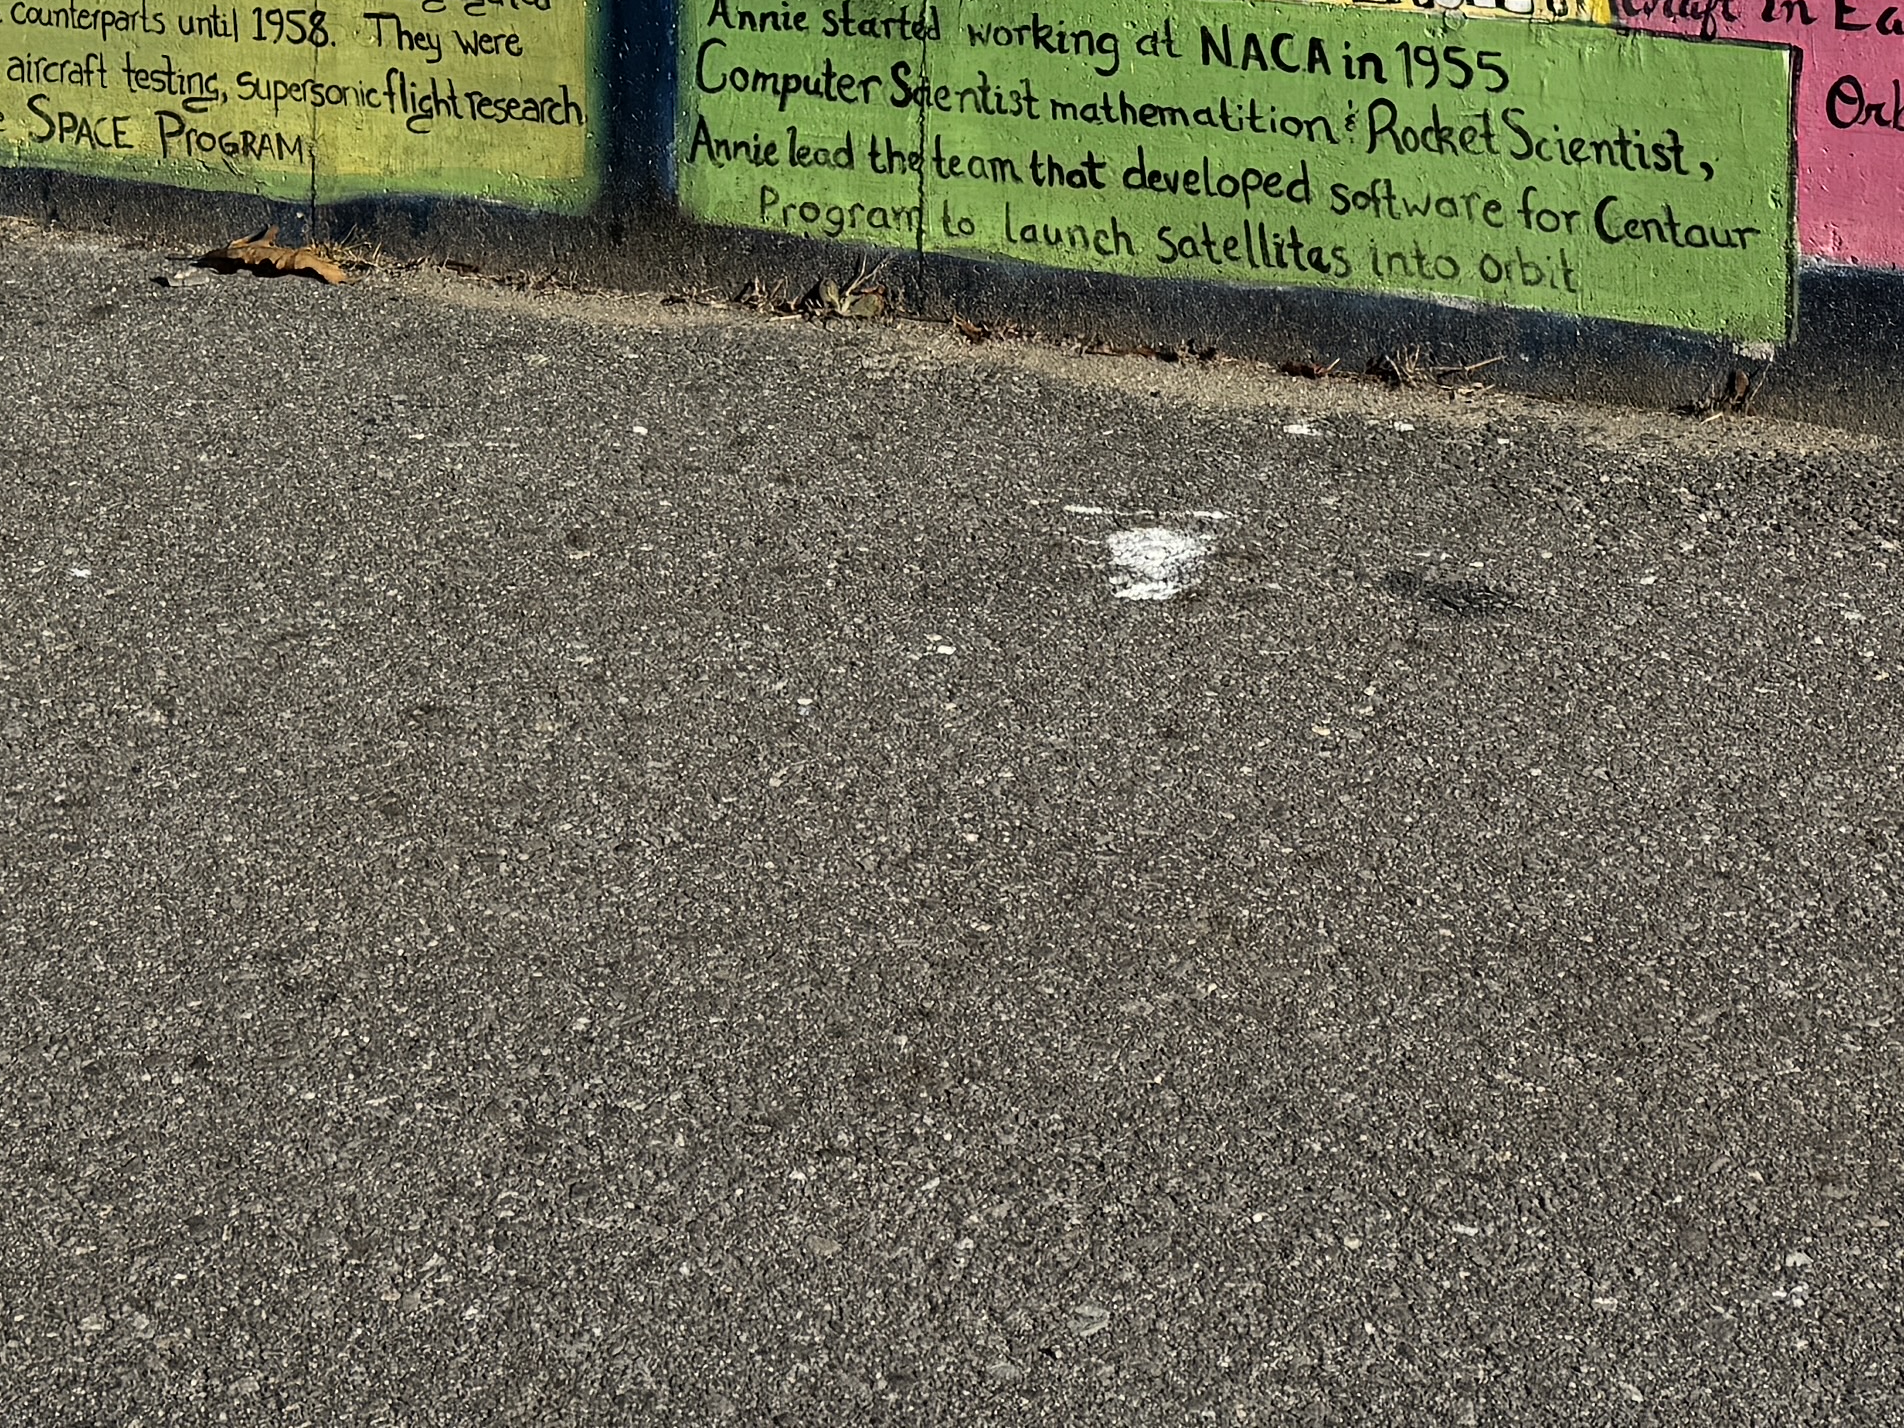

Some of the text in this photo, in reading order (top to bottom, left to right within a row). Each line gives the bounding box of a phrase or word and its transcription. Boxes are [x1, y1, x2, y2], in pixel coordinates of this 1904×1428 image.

[821, 0, 941, 41] started
[967, 12, 1120, 75] working
[1135, 19, 1183, 59] at
[1342, 49, 1387, 85] in
[1396, 42, 1511, 93] 1955
